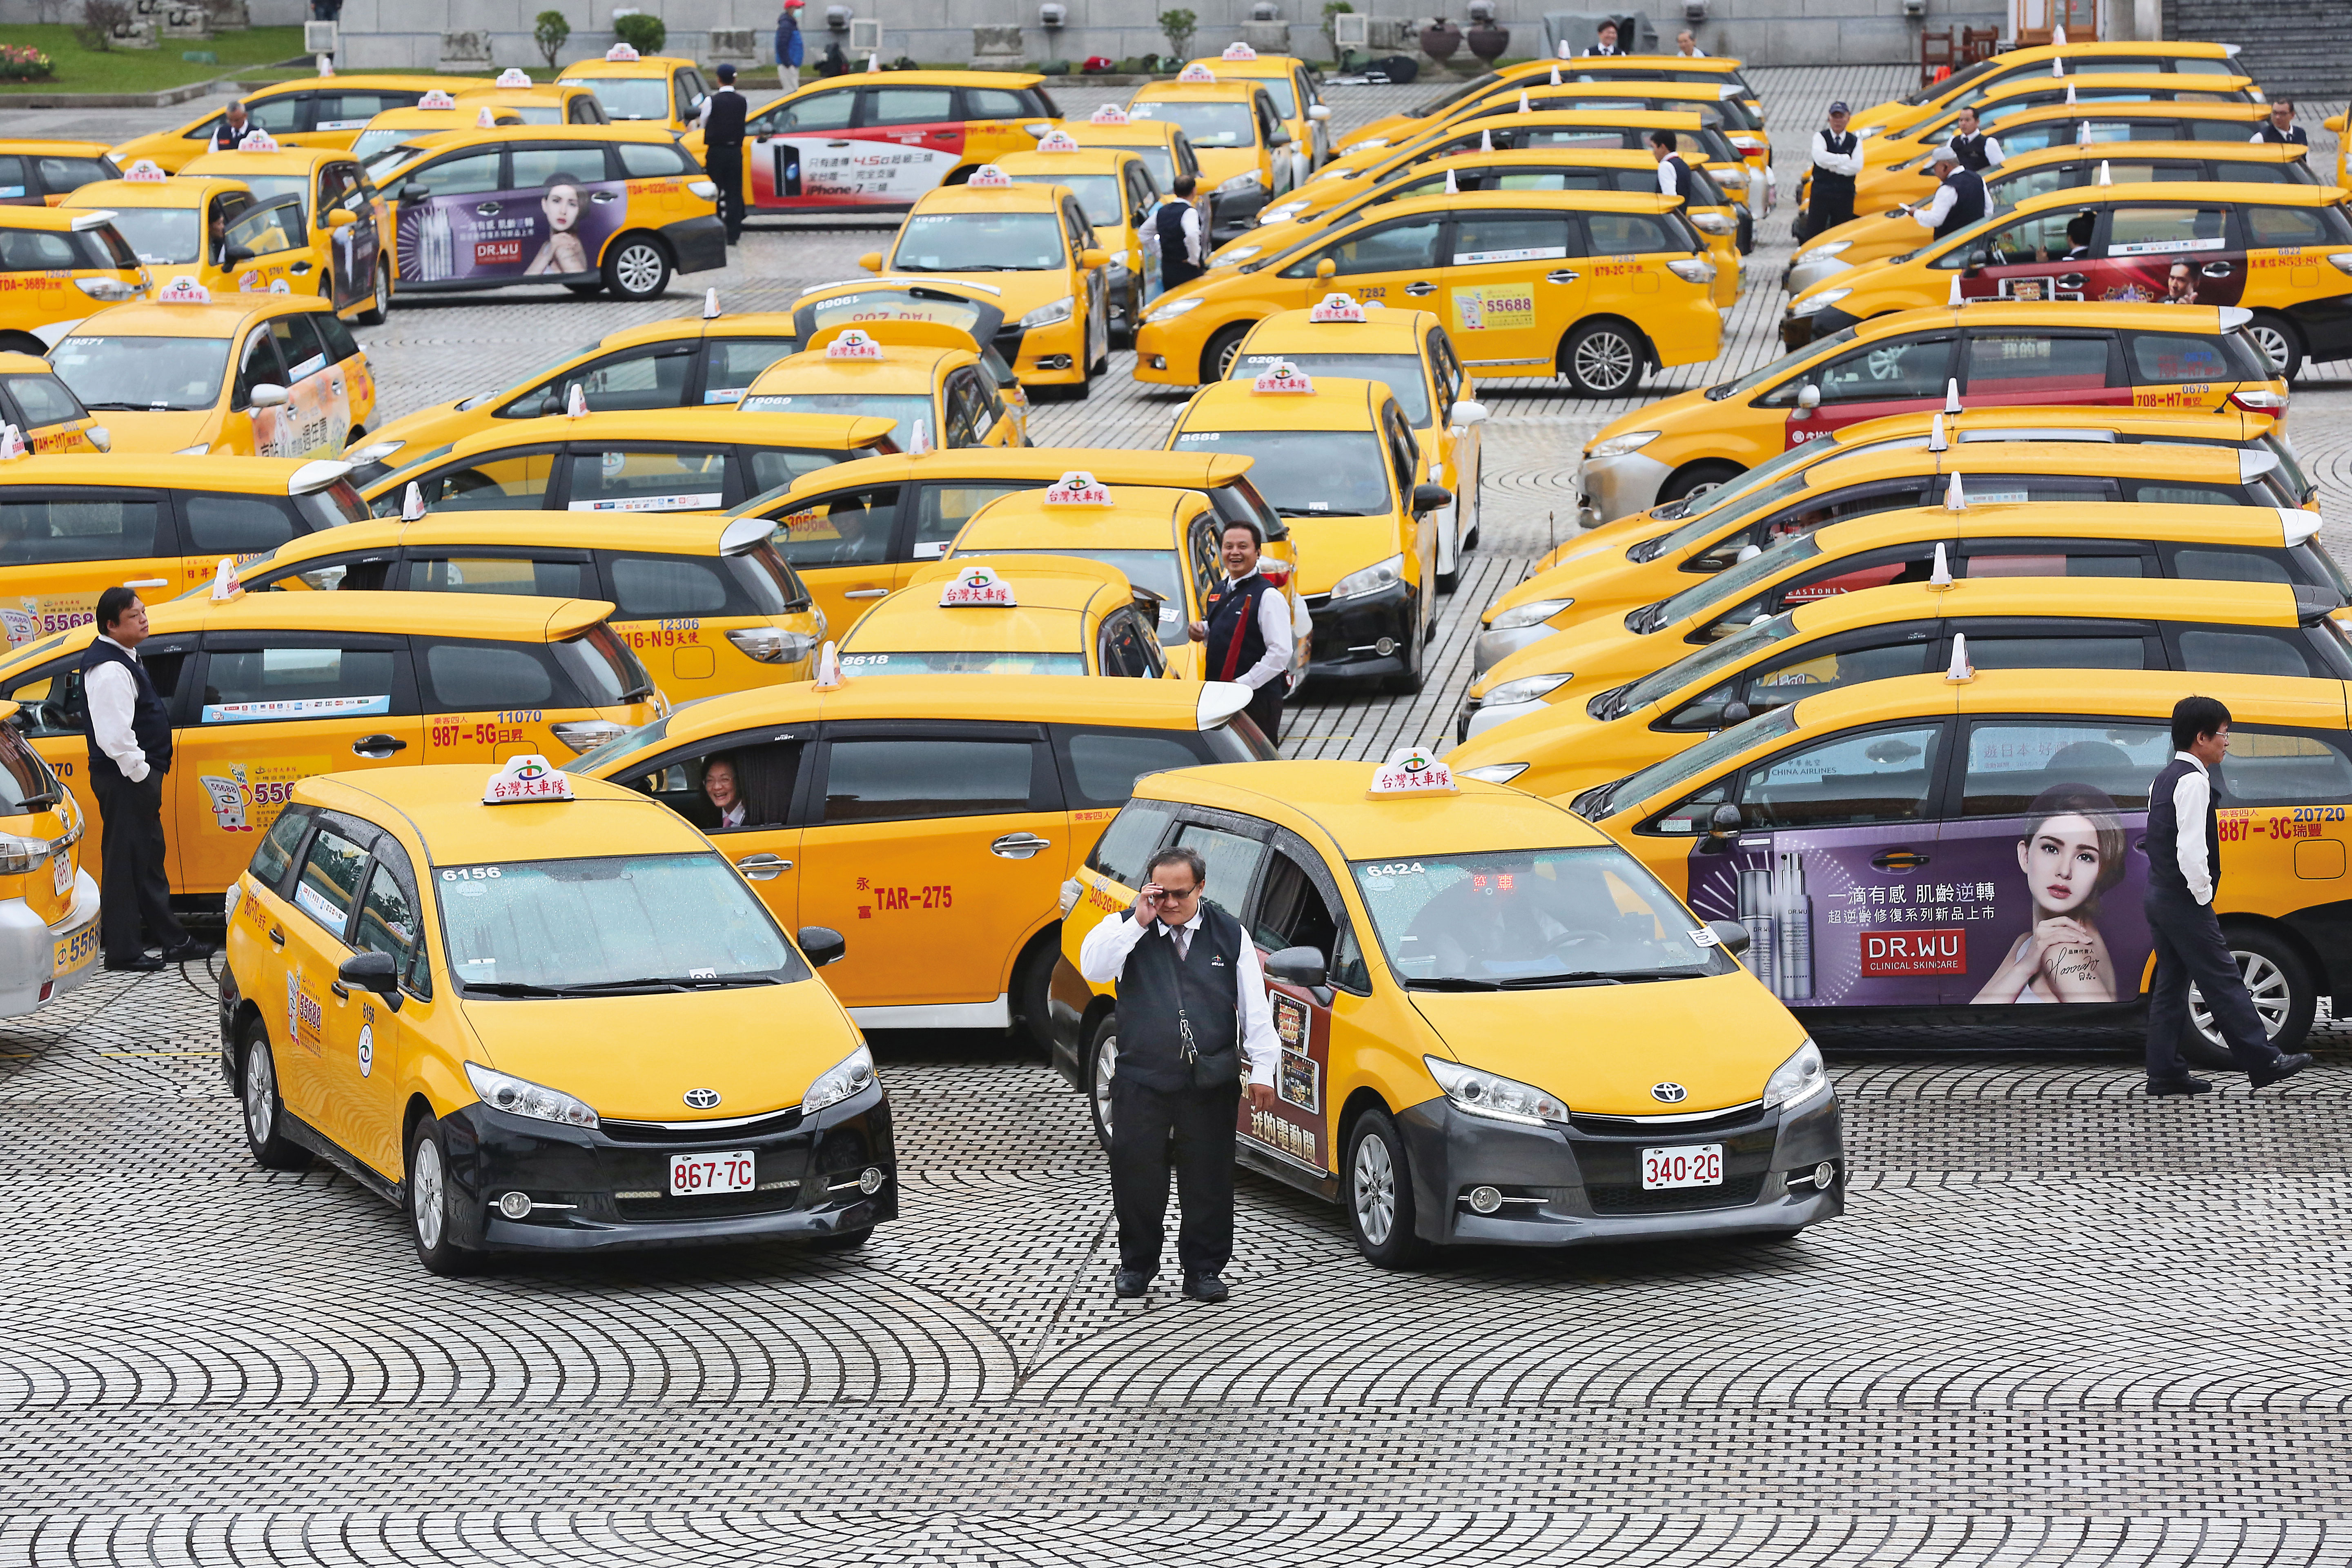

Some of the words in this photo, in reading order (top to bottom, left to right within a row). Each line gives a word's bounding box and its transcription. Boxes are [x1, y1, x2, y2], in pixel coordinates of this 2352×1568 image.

[807, 185, 851, 196] iPhone
[856, 183, 863, 193] 7
[477, 243, 519, 257] DR.WU
[1358, 287, 1386, 298] 7282
[1487, 298, 1532, 312] 55688
[1315, 308, 1360, 318] 台灣大車隊
[830, 346, 876, 356] 台灣大車隊
[1258, 378, 1307, 389] 台灣大車隊
[2183, 385, 2209, 394] 0679
[746, 397, 792, 405] 19069
[2136, 392, 2181, 407] 708-H7
[1180, 433, 1220, 441] 8688
[1048, 490, 1105, 501] 台灣大車隊
[947, 588, 1008, 601] 台灣大車隊
[658, 618, 699, 630] 12306
[677, 632, 699, 644] 天使
[841, 655, 889, 666] 8618
[497, 710, 542, 724] 11070
[432, 723, 496, 747] 987-5G
[1800, 767, 1837, 775] AIRLINES
[1382, 769, 1449, 789] 台灣大車隊
[211, 784, 237, 793] 55688
[494, 780, 566, 797] 台灣大車隊
[1075, 811, 1111, 821] 乘客四人
[2220, 809, 2259, 817] 乘客四人
[2293, 807, 2345, 823] 20720
[2218, 817, 2292, 842] 887-3C
[2293, 823, 2322, 837] 瑞豐
[442, 867, 501, 881] 6156
[1366, 862, 1425, 877] 6424
[1092, 875, 1112, 893] 6424
[874, 885, 952, 911] TAR-275
[1828, 884, 1907, 905] 一滴有感
[1916, 881, 1996, 904] 肌齡逆轉
[1089, 888, 1112, 913] 340-2G
[1828, 905, 1995, 924] 超逆齡修復系列新品上市
[1693, 930, 1713, 944] 101
[1869, 936, 1958, 958] DR.WU
[1870, 962, 1911, 971] CLINICAL
[1913, 960, 1958, 969] SKINCARE
[299, 992, 321, 1032] 55688
[363, 1002, 375, 1024] 6156
[675, 1160, 751, 1189] 867-7C
[1646, 1154, 1719, 1183] 340-2G
